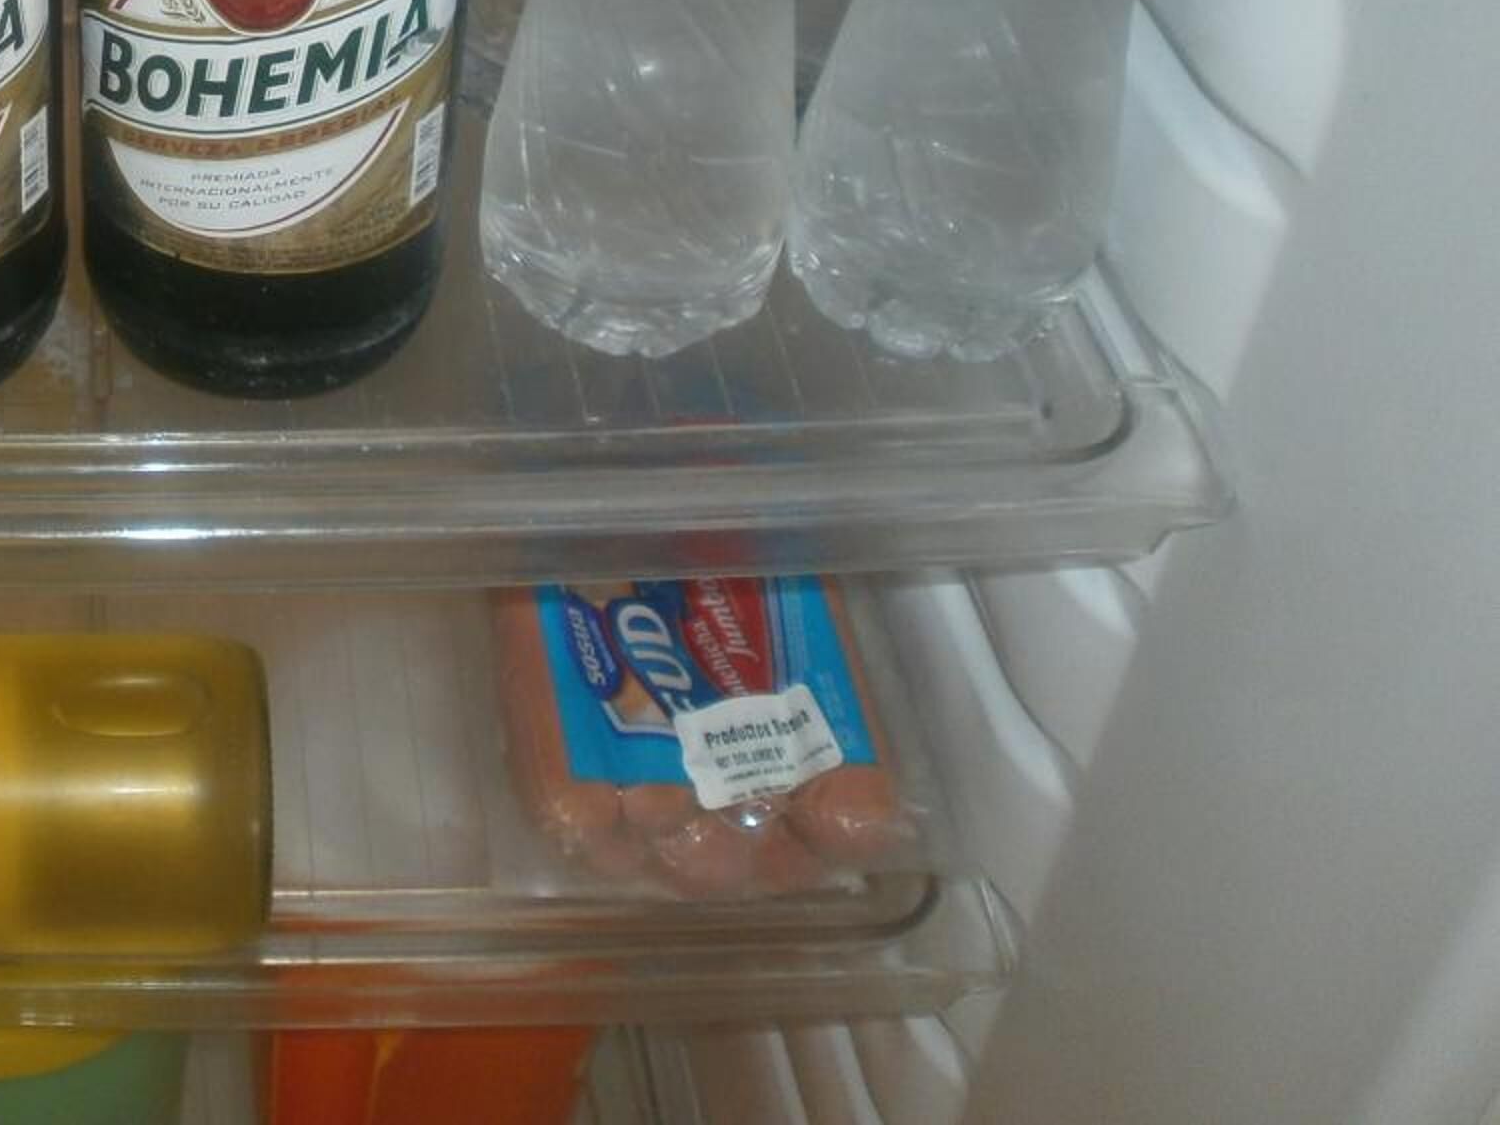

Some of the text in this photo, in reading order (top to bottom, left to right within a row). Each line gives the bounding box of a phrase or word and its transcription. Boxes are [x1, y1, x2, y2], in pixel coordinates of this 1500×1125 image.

[190, 167, 282, 183] PREMIADA
[197, 201, 221, 211] SU
[229, 190, 307, 210] CALIDAD
